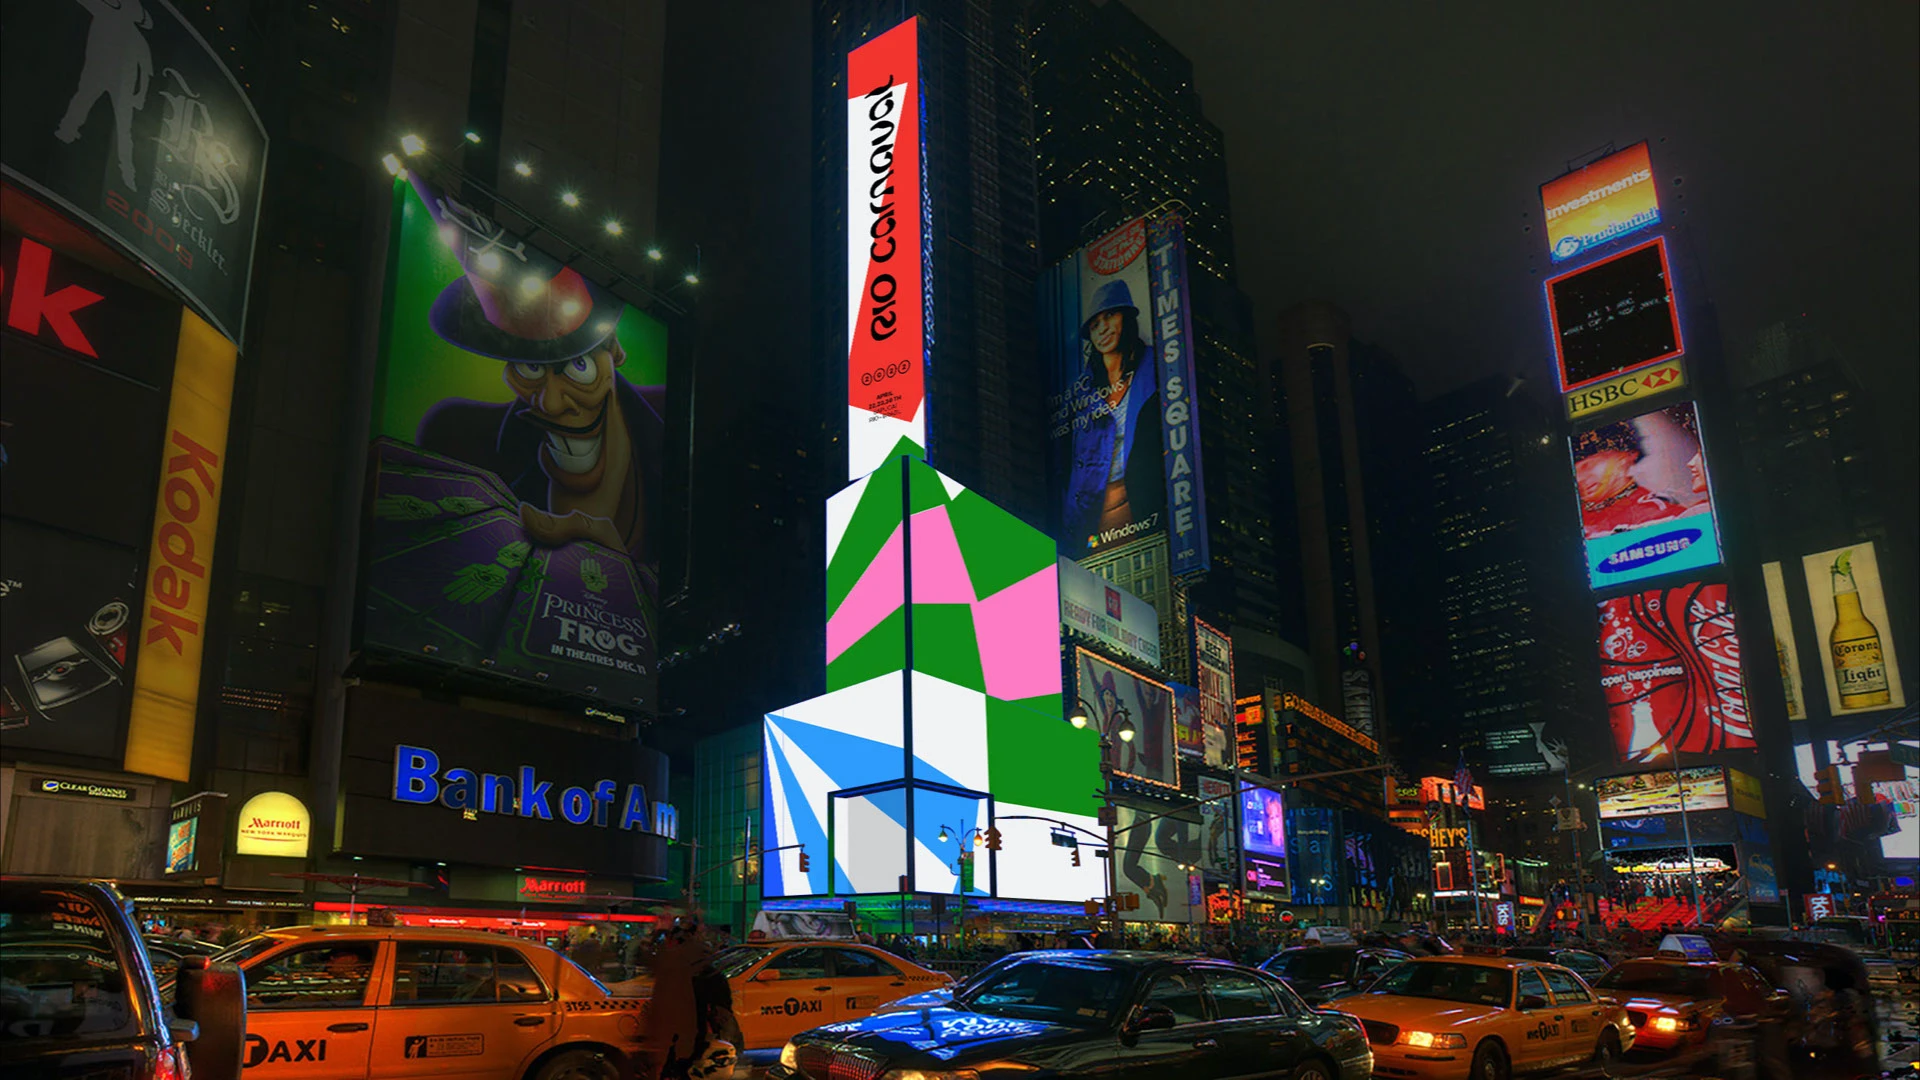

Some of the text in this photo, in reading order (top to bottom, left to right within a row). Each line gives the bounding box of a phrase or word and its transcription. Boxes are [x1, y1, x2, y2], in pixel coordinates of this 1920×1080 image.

[1546, 167, 1651, 220] investments
[1581, 207, 1659, 247] Prudential
[0, 237, 105, 360] k
[1070, 379, 1125, 413] Windows
[1126, 371, 1135, 387] 7
[1073, 376, 1090, 396] PC
[1153, 242, 1194, 534] TIMES SQUARE
[1569, 377, 1640, 414] HSBC
[1072, 412, 1090, 431] my
[146, 430, 219, 656] Kodak
[1100, 512, 1159, 544] Windows 7
[1607, 535, 1691, 567] SAMSUNG
[541, 592, 647, 638] PRINCESS
[554, 615, 646, 656] FROG
[1834, 640, 1879, 657] Corona
[551, 644, 564, 655] IN
[565, 647, 615, 667] THEATRES
[1601, 665, 1684, 687] open happiness
[1843, 667, 1882, 684] Light
[392, 743, 553, 821] Bank
[560, 778, 616, 828] of
[248, 817, 301, 829] Marriott
[520, 877, 587, 894] Marriott
[1496, 904, 1509, 926] tkts
[784, 997, 822, 1016] TAXI
[244, 1034, 327, 1068] TAXI
